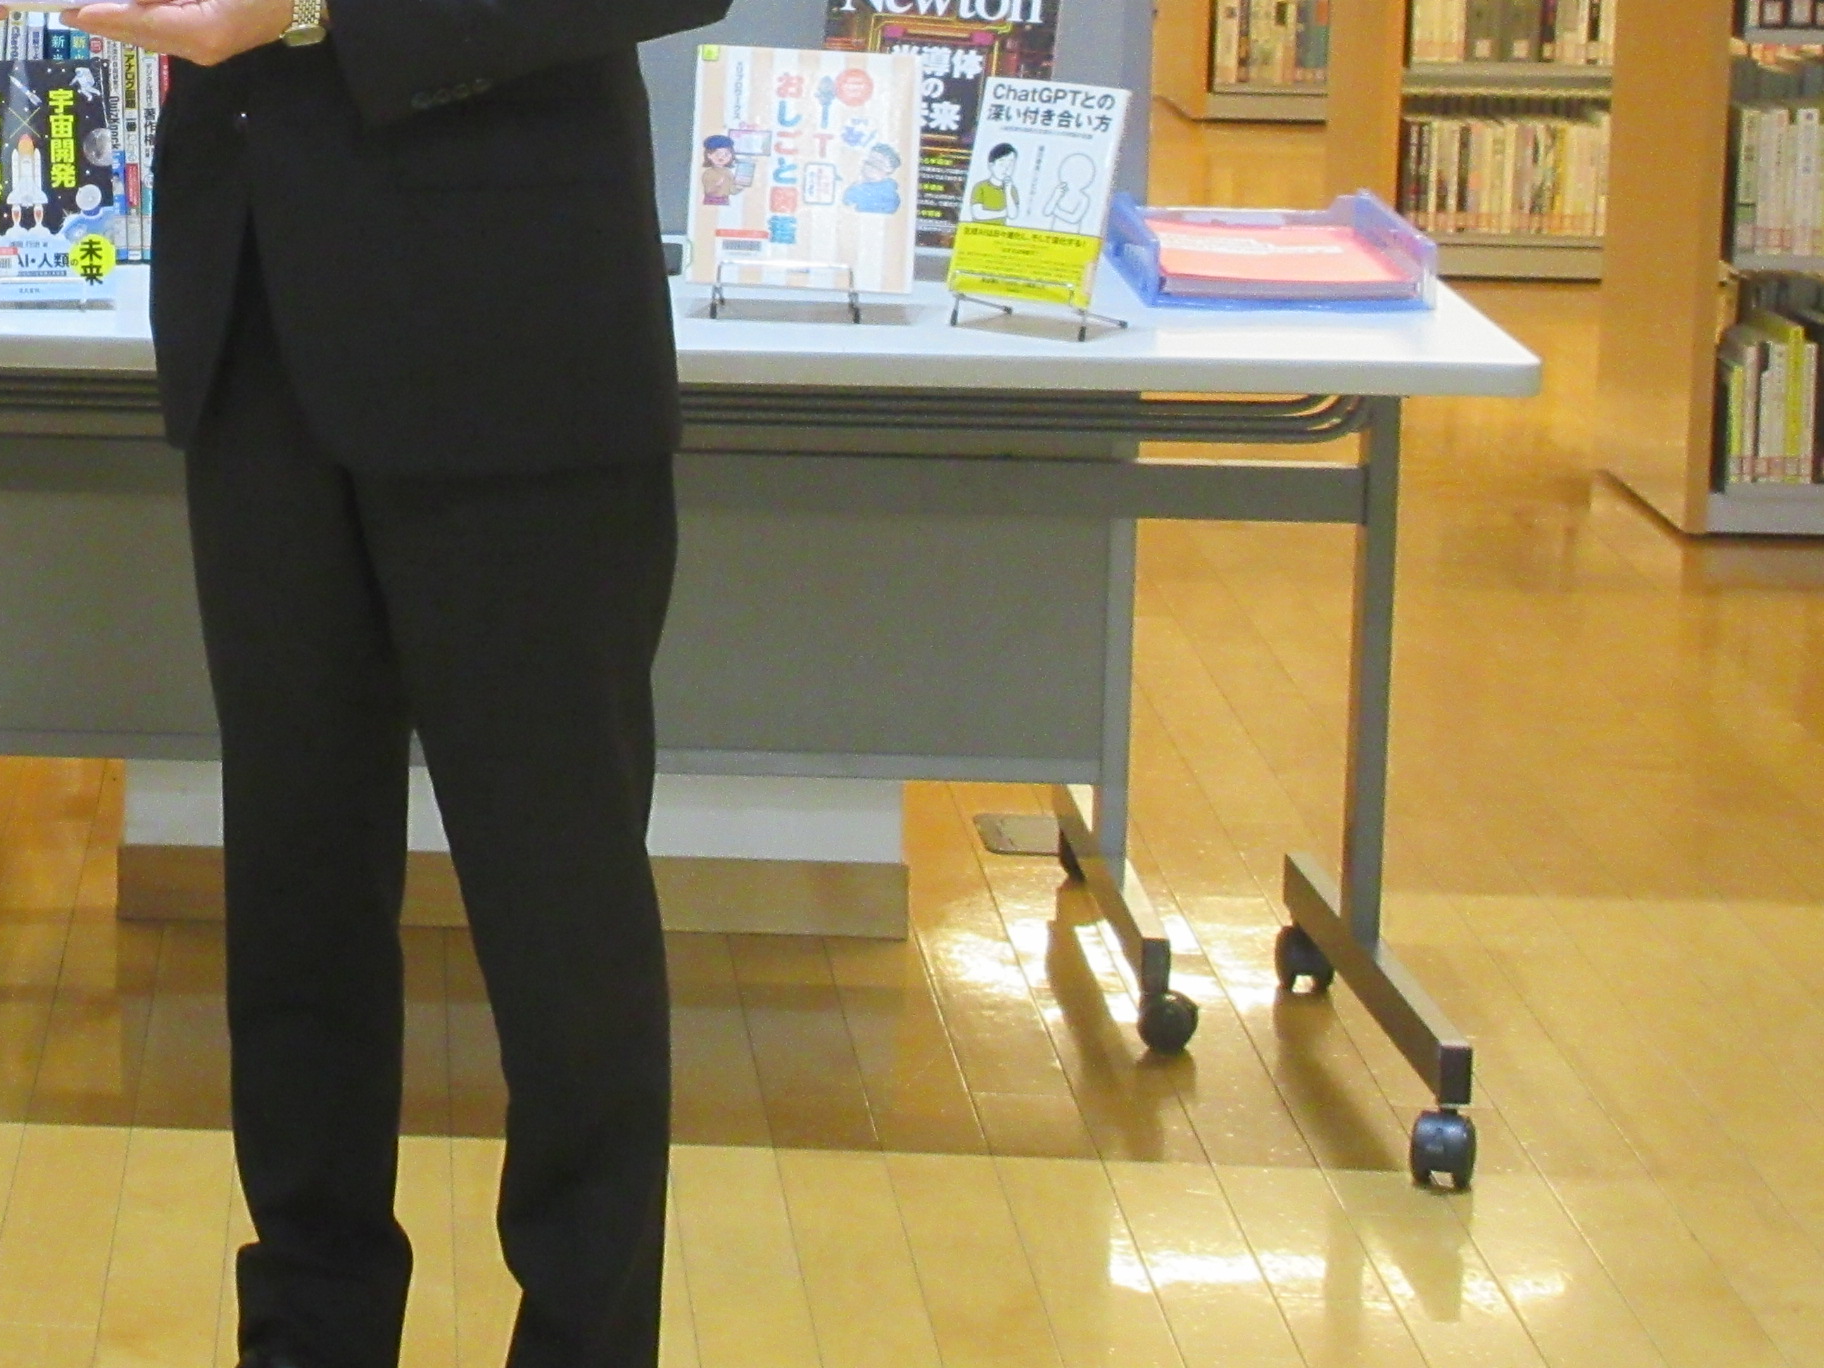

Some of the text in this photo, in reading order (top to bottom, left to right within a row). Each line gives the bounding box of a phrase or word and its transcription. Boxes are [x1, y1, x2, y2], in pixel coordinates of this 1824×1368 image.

[992, 83, 1117, 110] ChatGPTとの
[987, 103, 1113, 133] 深い付き合い方
[48, 88, 77, 189] 宇宙開発
[79, 238, 104, 286] 未来
